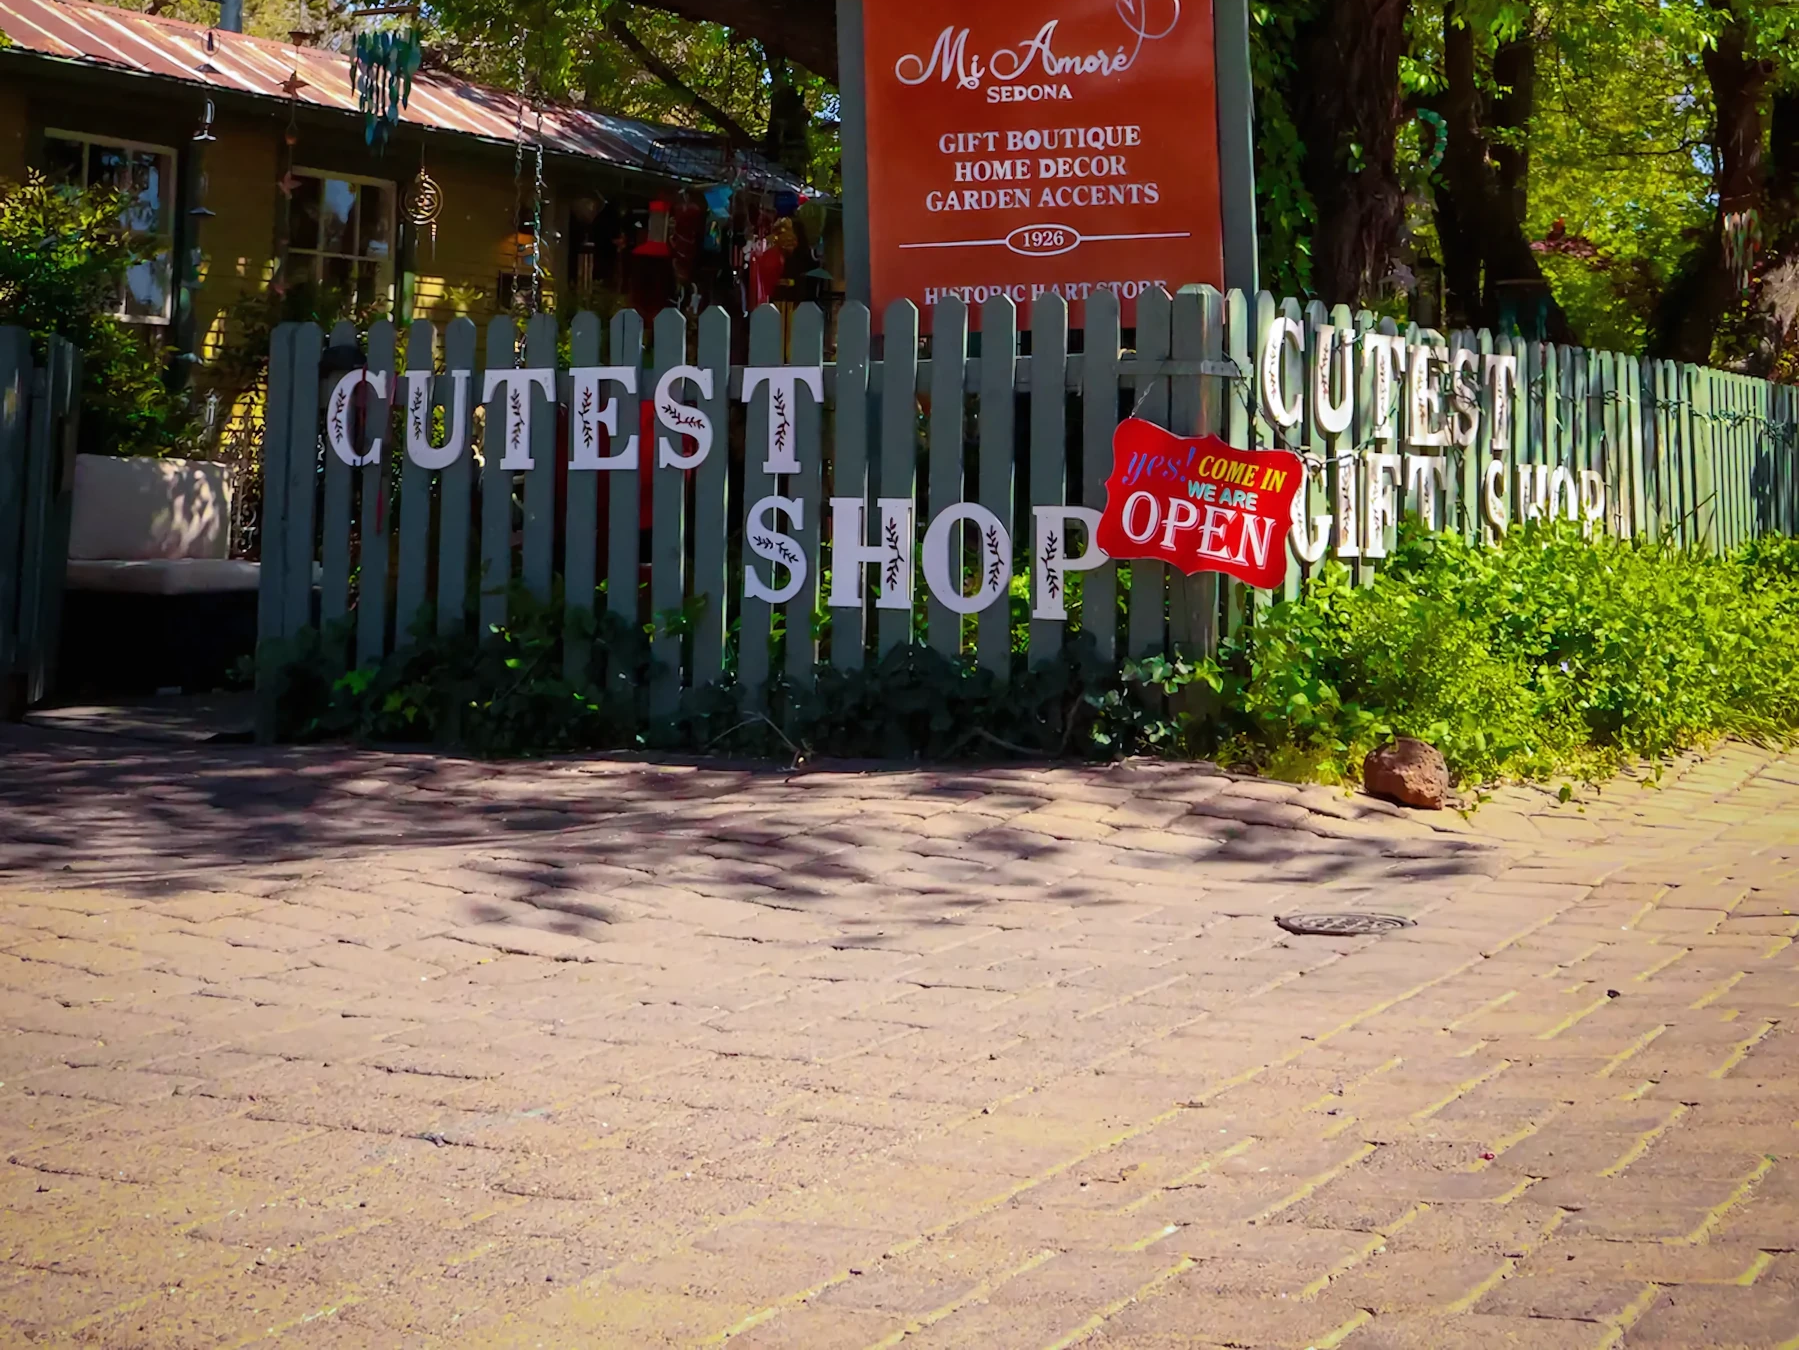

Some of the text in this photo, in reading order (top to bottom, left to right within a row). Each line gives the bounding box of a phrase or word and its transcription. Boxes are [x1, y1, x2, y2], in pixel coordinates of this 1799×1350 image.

[895, 10, 1143, 90] Mi Amoré
[986, 84, 1073, 104] SEDONA
[938, 125, 1142, 154] GIFT BOUTIQUE
[954, 155, 1128, 182] HOME DECOR
[926, 182, 1160, 212] GARDEN ACCENTS
[1022, 230, 1066, 248] 1926
[1262, 316, 1517, 451] CUTEST
[327, 364, 825, 475] CUTEST
[1198, 455, 1259, 488] COME
[1260, 468, 1288, 493] IN
[1187, 479, 1259, 512] WE ARE
[1289, 449, 1448, 562] GIFT
[1121, 491, 1277, 570] OPEN
[744, 495, 1112, 620] SHOP
